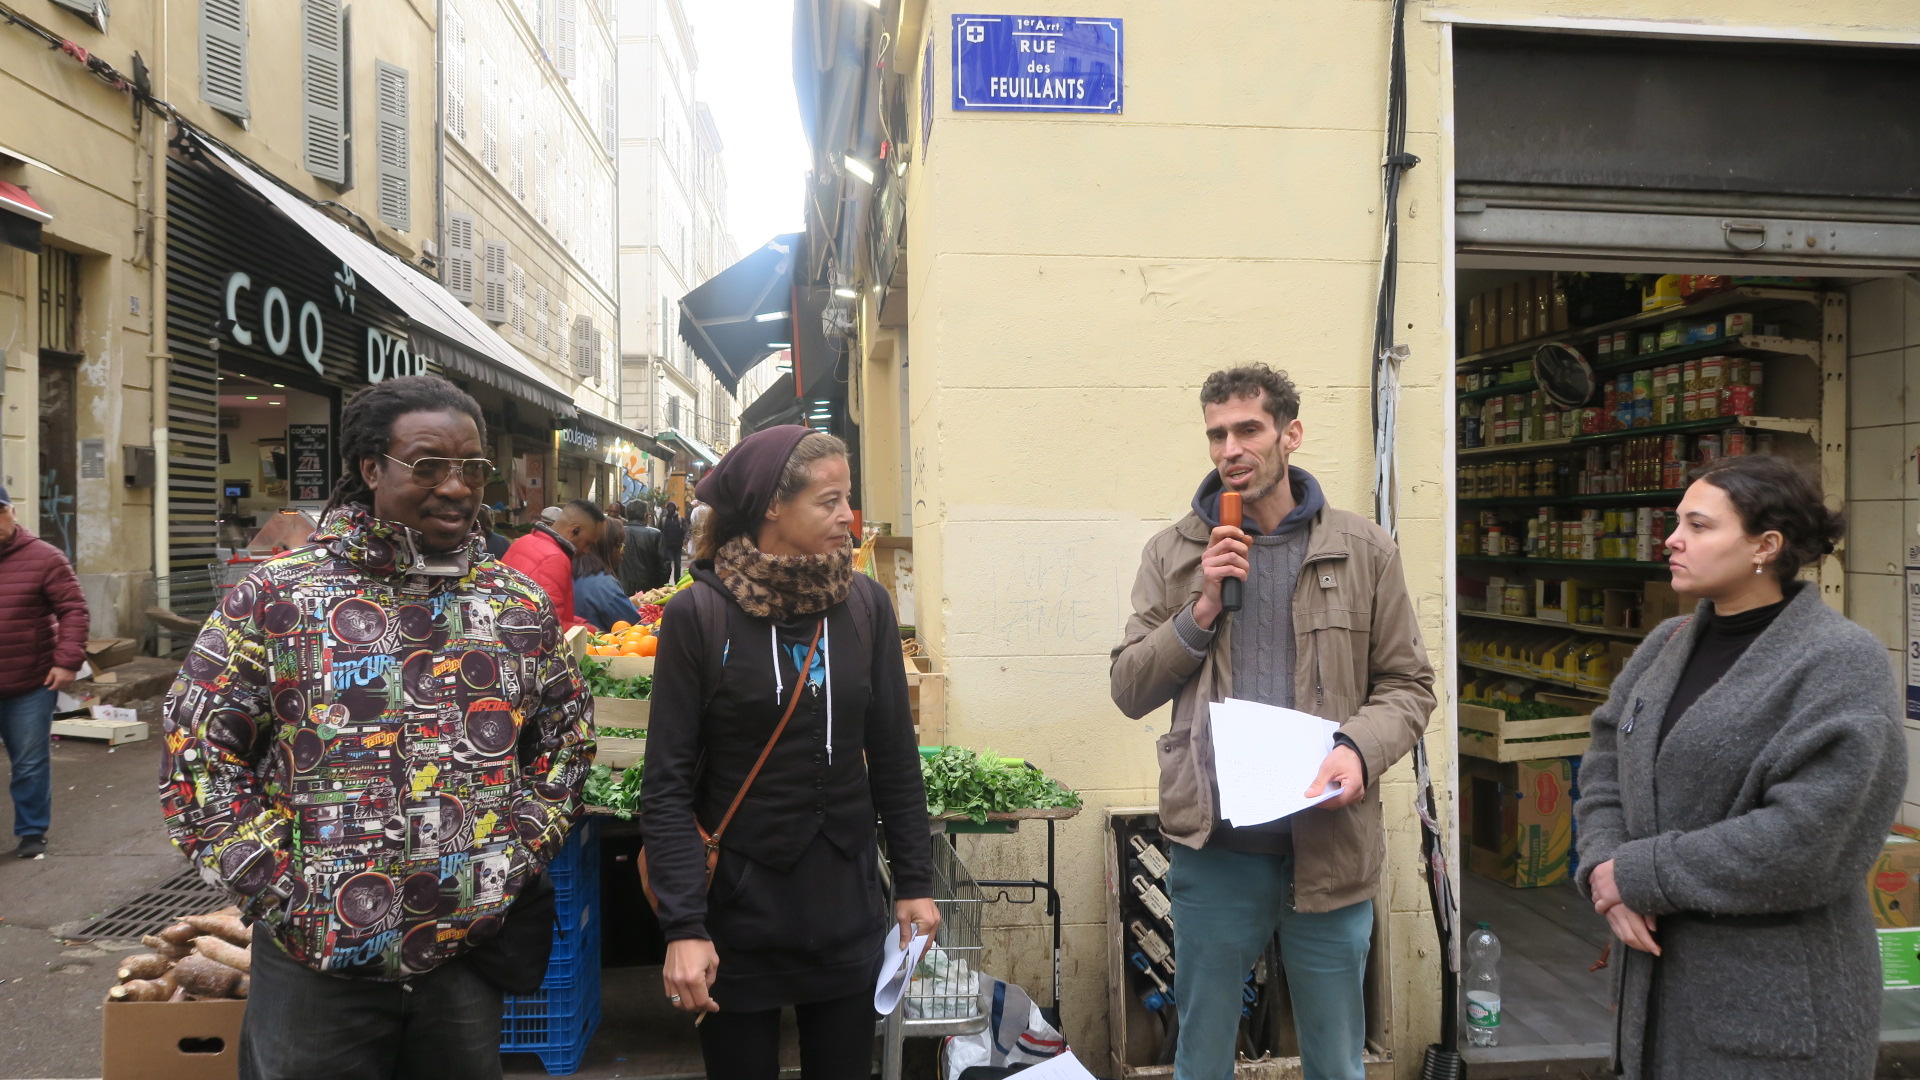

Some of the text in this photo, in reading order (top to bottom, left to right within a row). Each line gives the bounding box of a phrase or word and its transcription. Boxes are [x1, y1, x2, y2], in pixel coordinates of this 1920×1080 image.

[1020, 40, 1056, 53] RUE
[1027, 60, 1050, 73] des
[990, 77, 1085, 99] FEUILLANTS
[226, 271, 324, 376] COQ
[563, 427, 597, 451] Boulangerie
[1539, 830, 1549, 882] BNANAS
